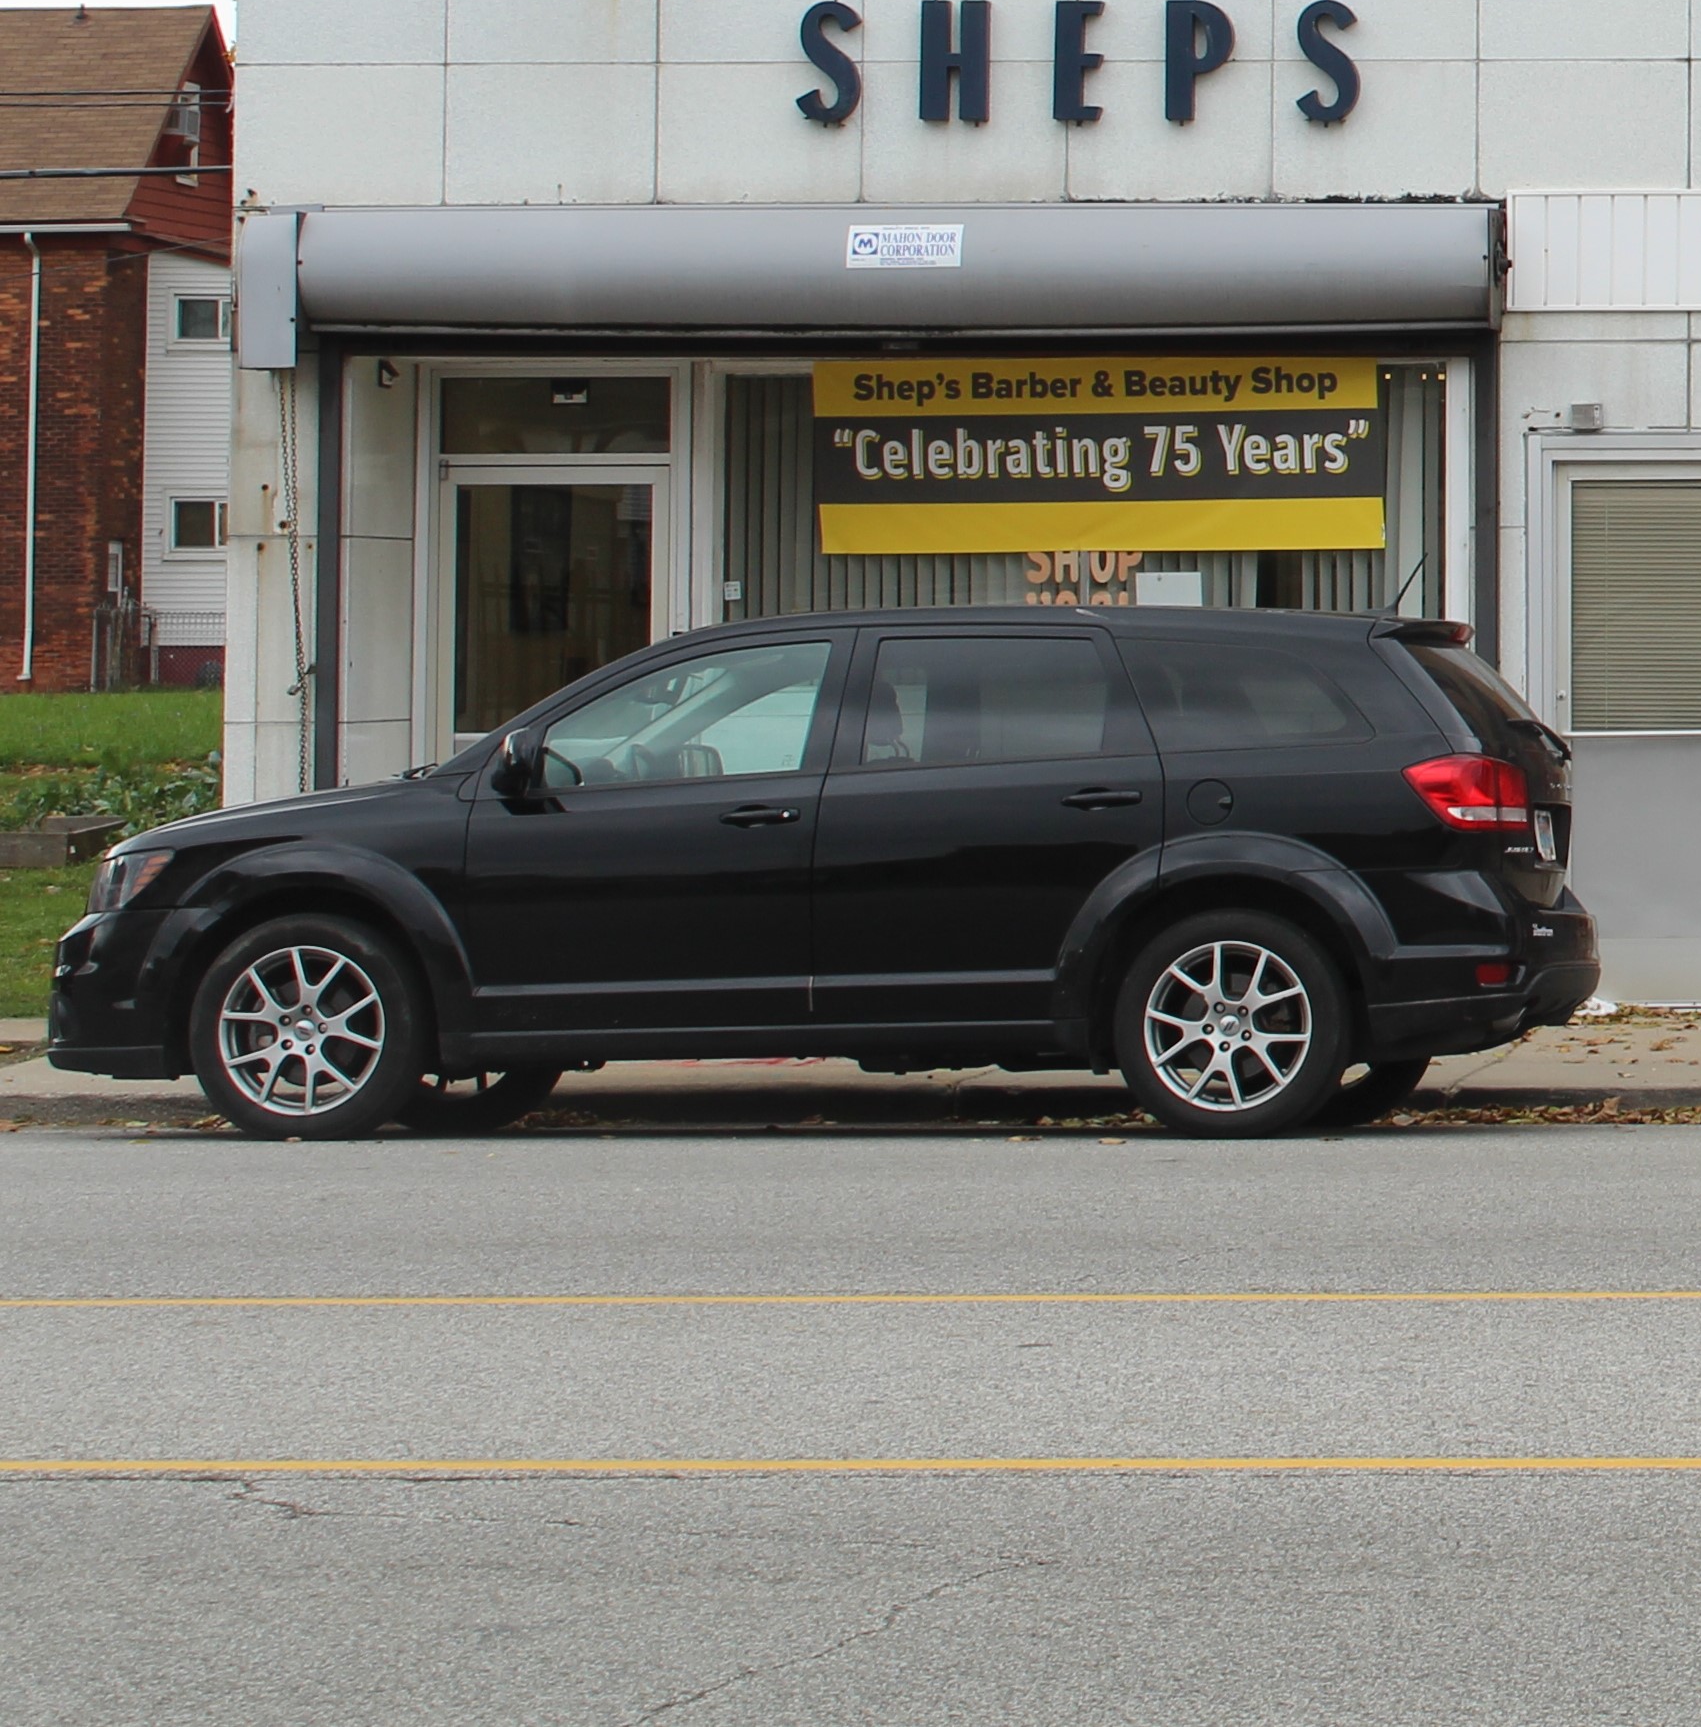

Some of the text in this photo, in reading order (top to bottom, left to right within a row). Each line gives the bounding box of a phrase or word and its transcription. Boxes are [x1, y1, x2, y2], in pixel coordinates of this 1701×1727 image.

[795, 0, 1360, 123] SHEPS
[880, 244, 956, 257] CORPORATION
[881, 233, 957, 244] MAHON DOOR
[853, 366, 1338, 406] Shep’s Barber & Beauty Shop
[1143, 424, 1202, 477] 75
[1027, 551, 1143, 584] SHOP
